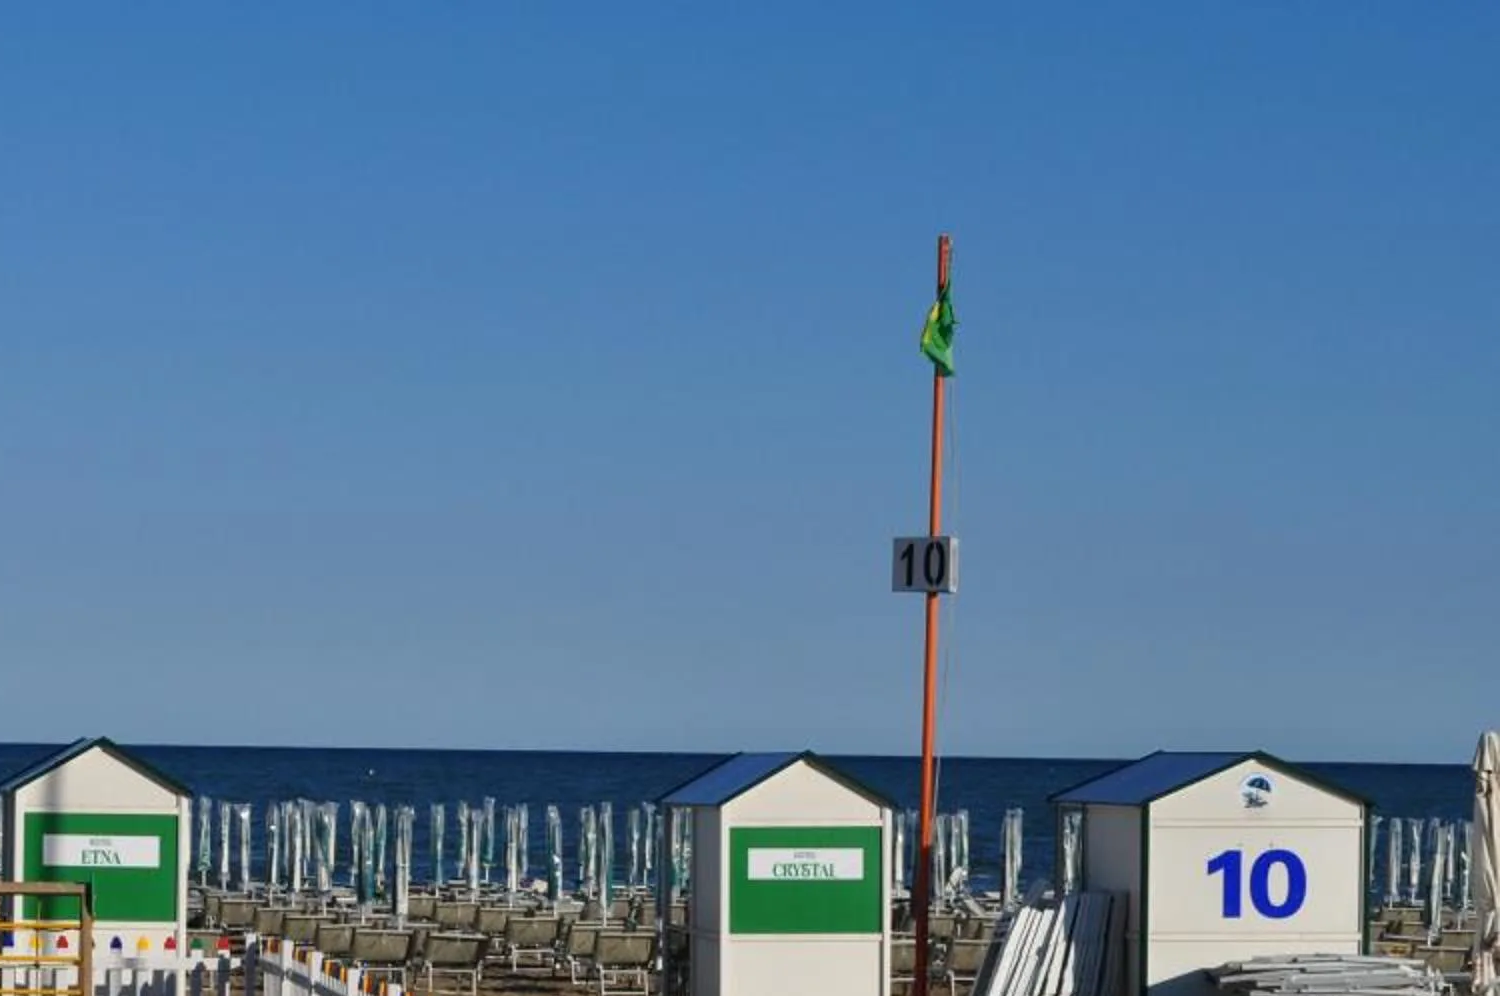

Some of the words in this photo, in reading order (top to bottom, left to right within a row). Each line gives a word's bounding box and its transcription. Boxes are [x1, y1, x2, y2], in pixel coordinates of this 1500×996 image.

[901, 542, 945, 588] 10
[81, 849, 121, 865] ETNA
[772, 863, 836, 878] CRYSTAL
[1207, 849, 1306, 918] 10
